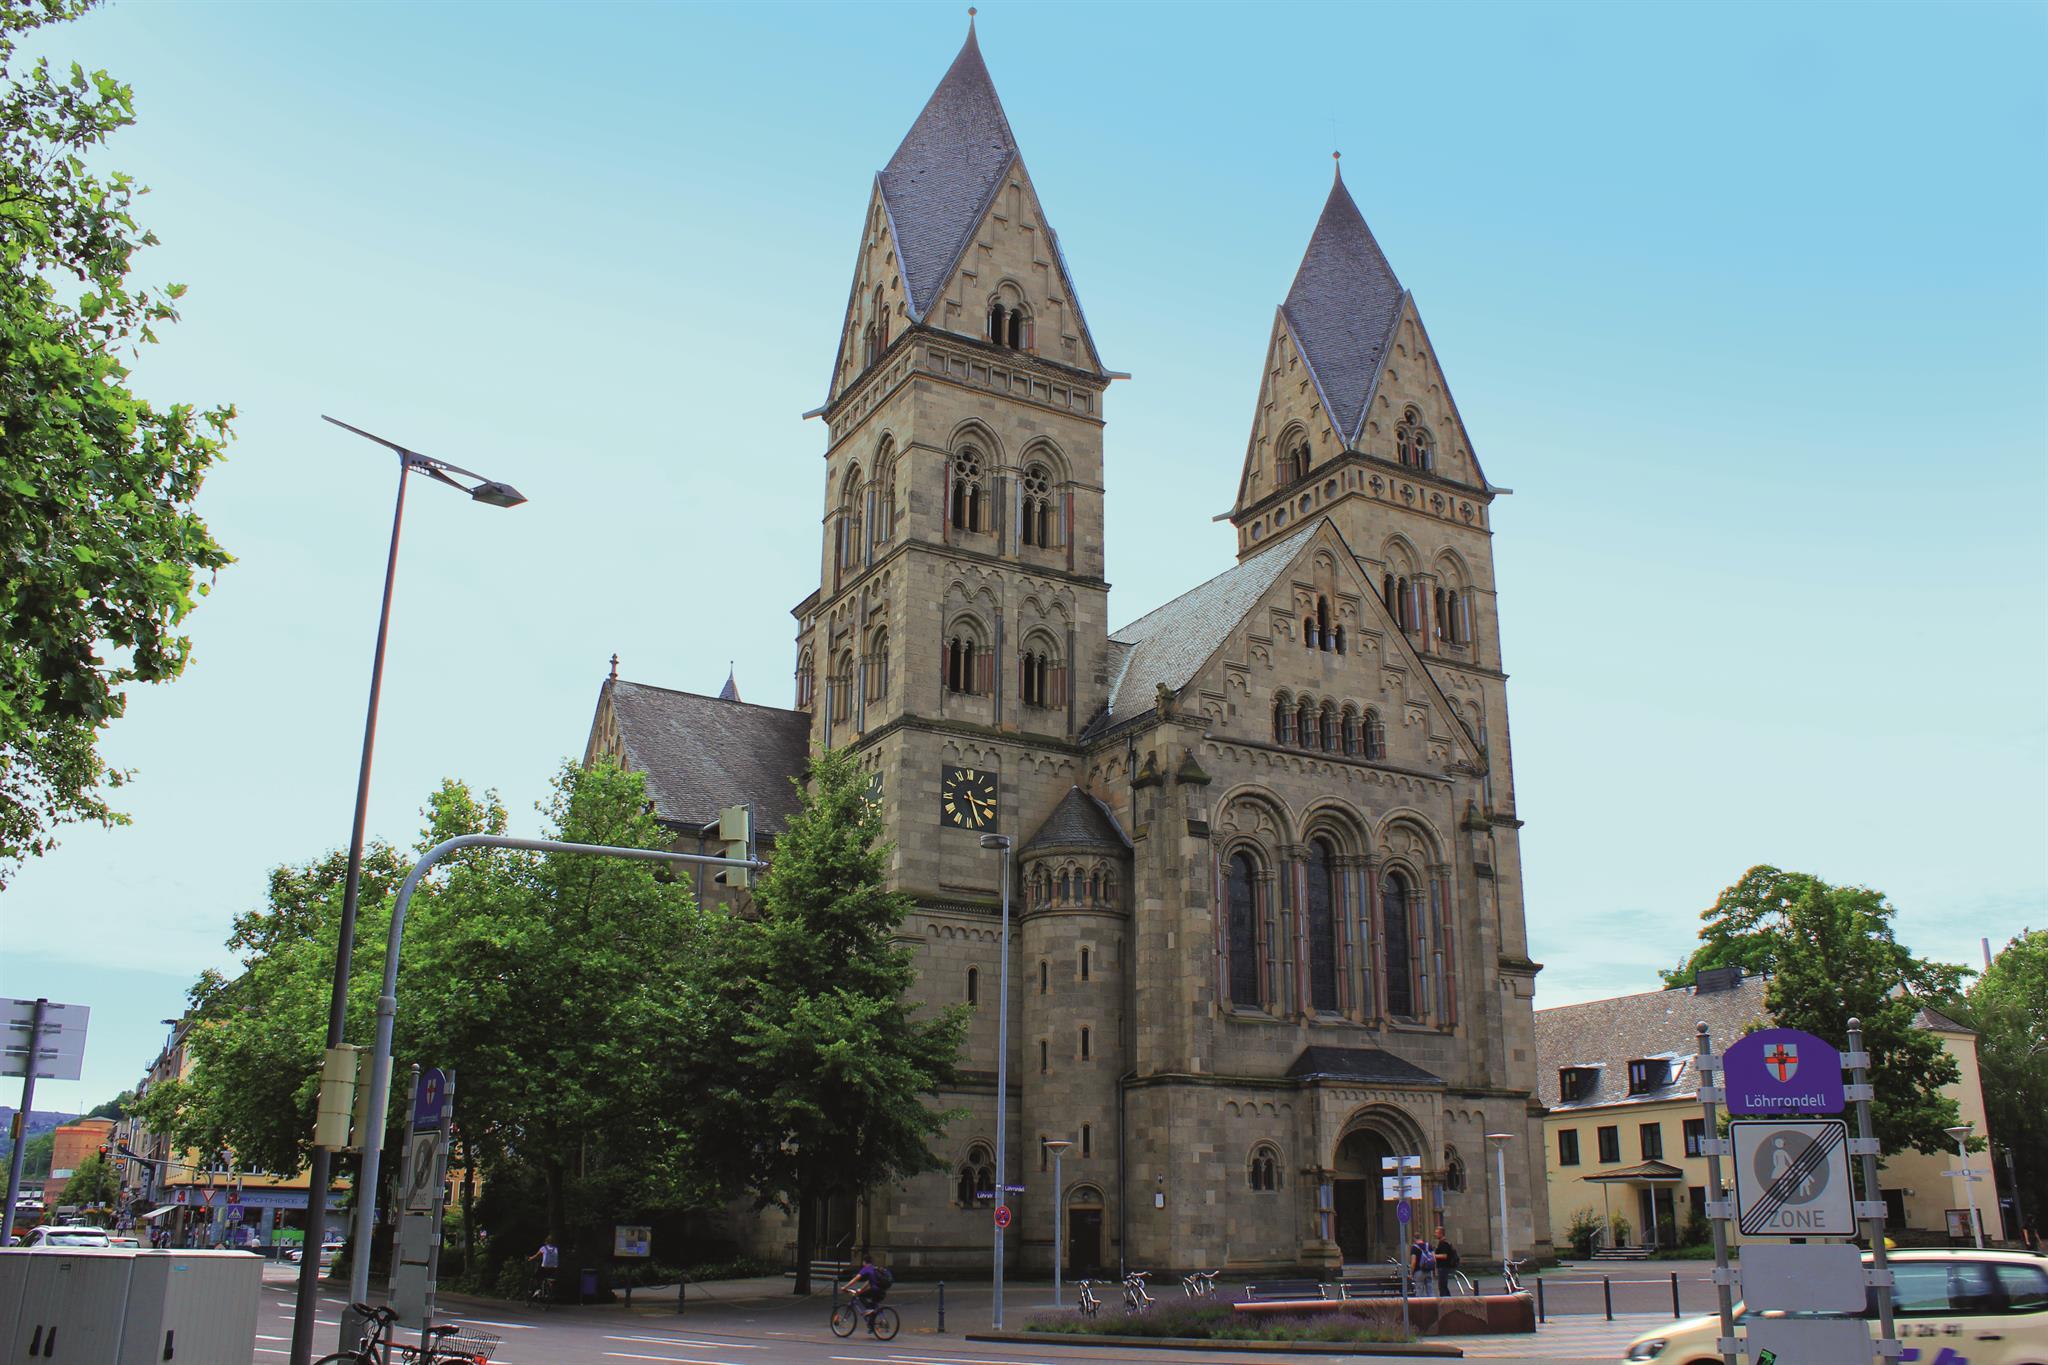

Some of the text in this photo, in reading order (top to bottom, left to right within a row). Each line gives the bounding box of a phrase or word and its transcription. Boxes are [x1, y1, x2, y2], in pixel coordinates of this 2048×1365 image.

[1744, 1093, 1827, 1108] Löhrrondell
[241, 1196, 299, 1205] POTHEKE
[1768, 1209, 1826, 1228] ZONE
